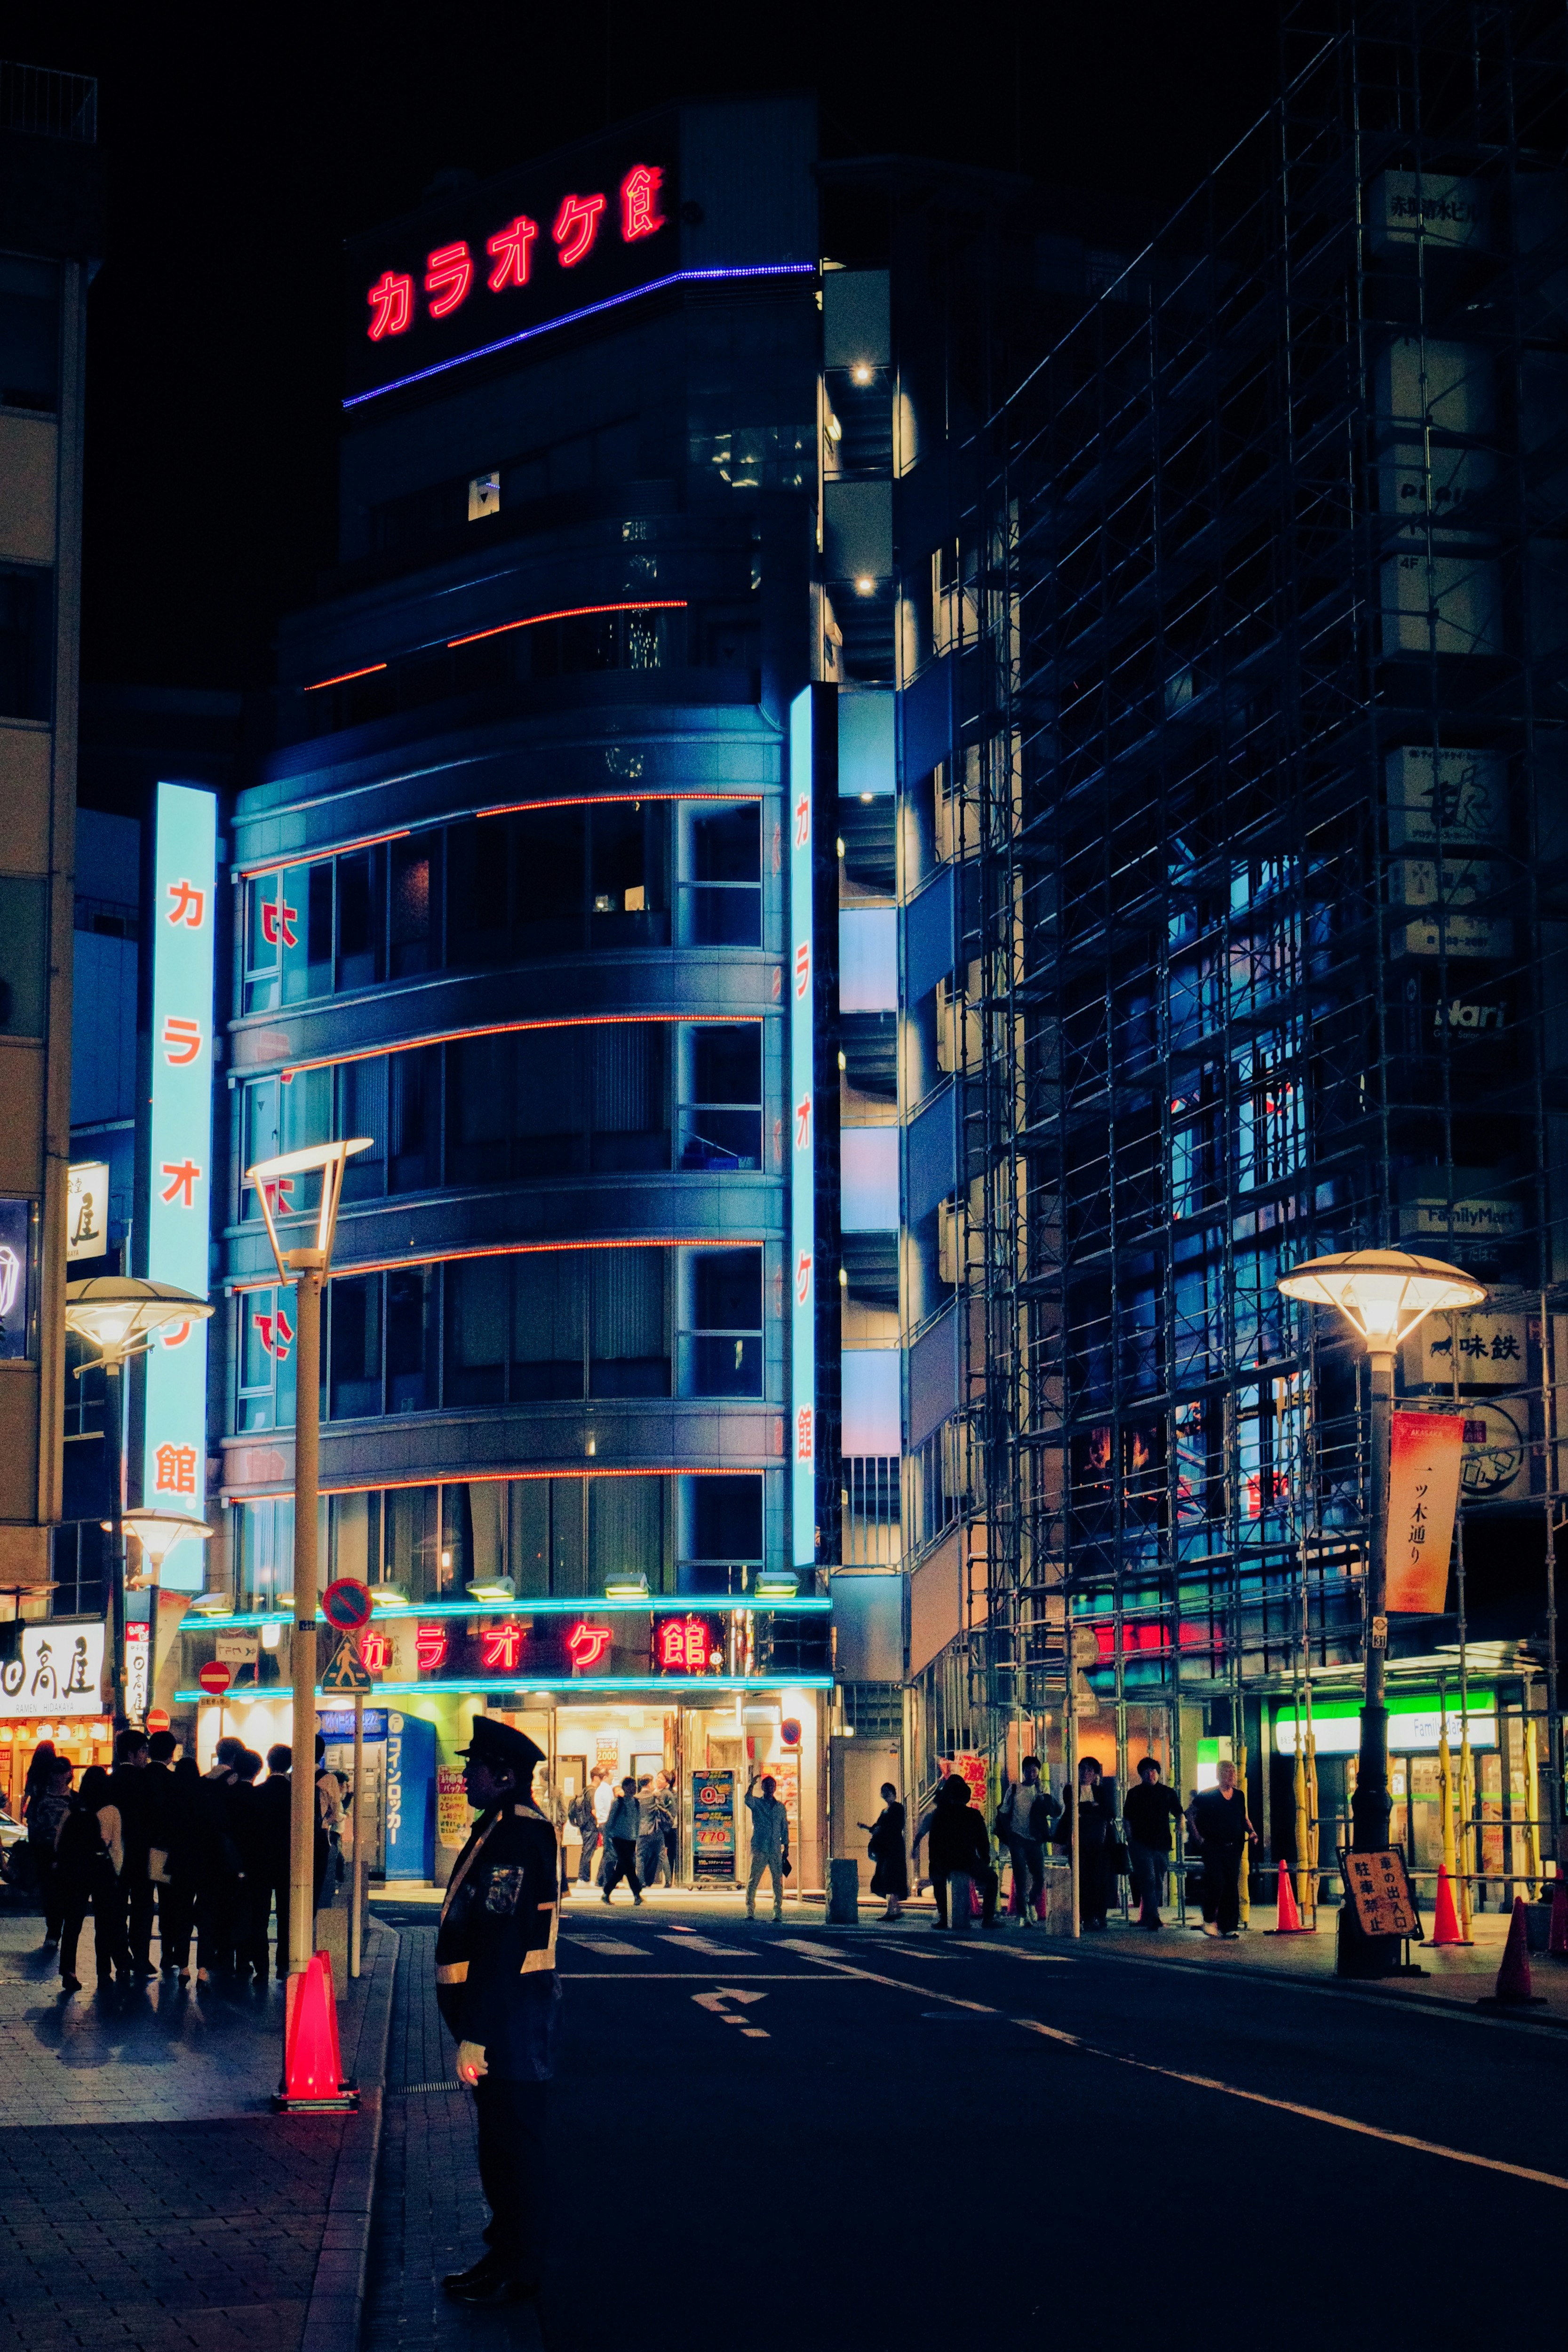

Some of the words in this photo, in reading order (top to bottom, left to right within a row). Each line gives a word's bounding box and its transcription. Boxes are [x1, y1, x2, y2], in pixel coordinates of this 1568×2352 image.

[1401, 557, 1419, 569] 4F
[796, 795, 812, 1459] カラオケ館
[71, 1192, 100, 1247] 屋
[1408, 1467, 1433, 1565] 一ツ木通り
[2, 1636, 95, 1699] 日高屋
[361, 1622, 708, 1671] カラオケ館
[16, 1704, 37, 1713] RAMEN
[43, 1702, 74, 1712] HIDAKAYA
[1414, 1716, 1461, 1737] Familar
[388, 1738, 401, 1844] コインロッカー
[1355, 1861, 1385, 1932] 駐車禁止
[1380, 1857, 1407, 1928] 車の出入口
